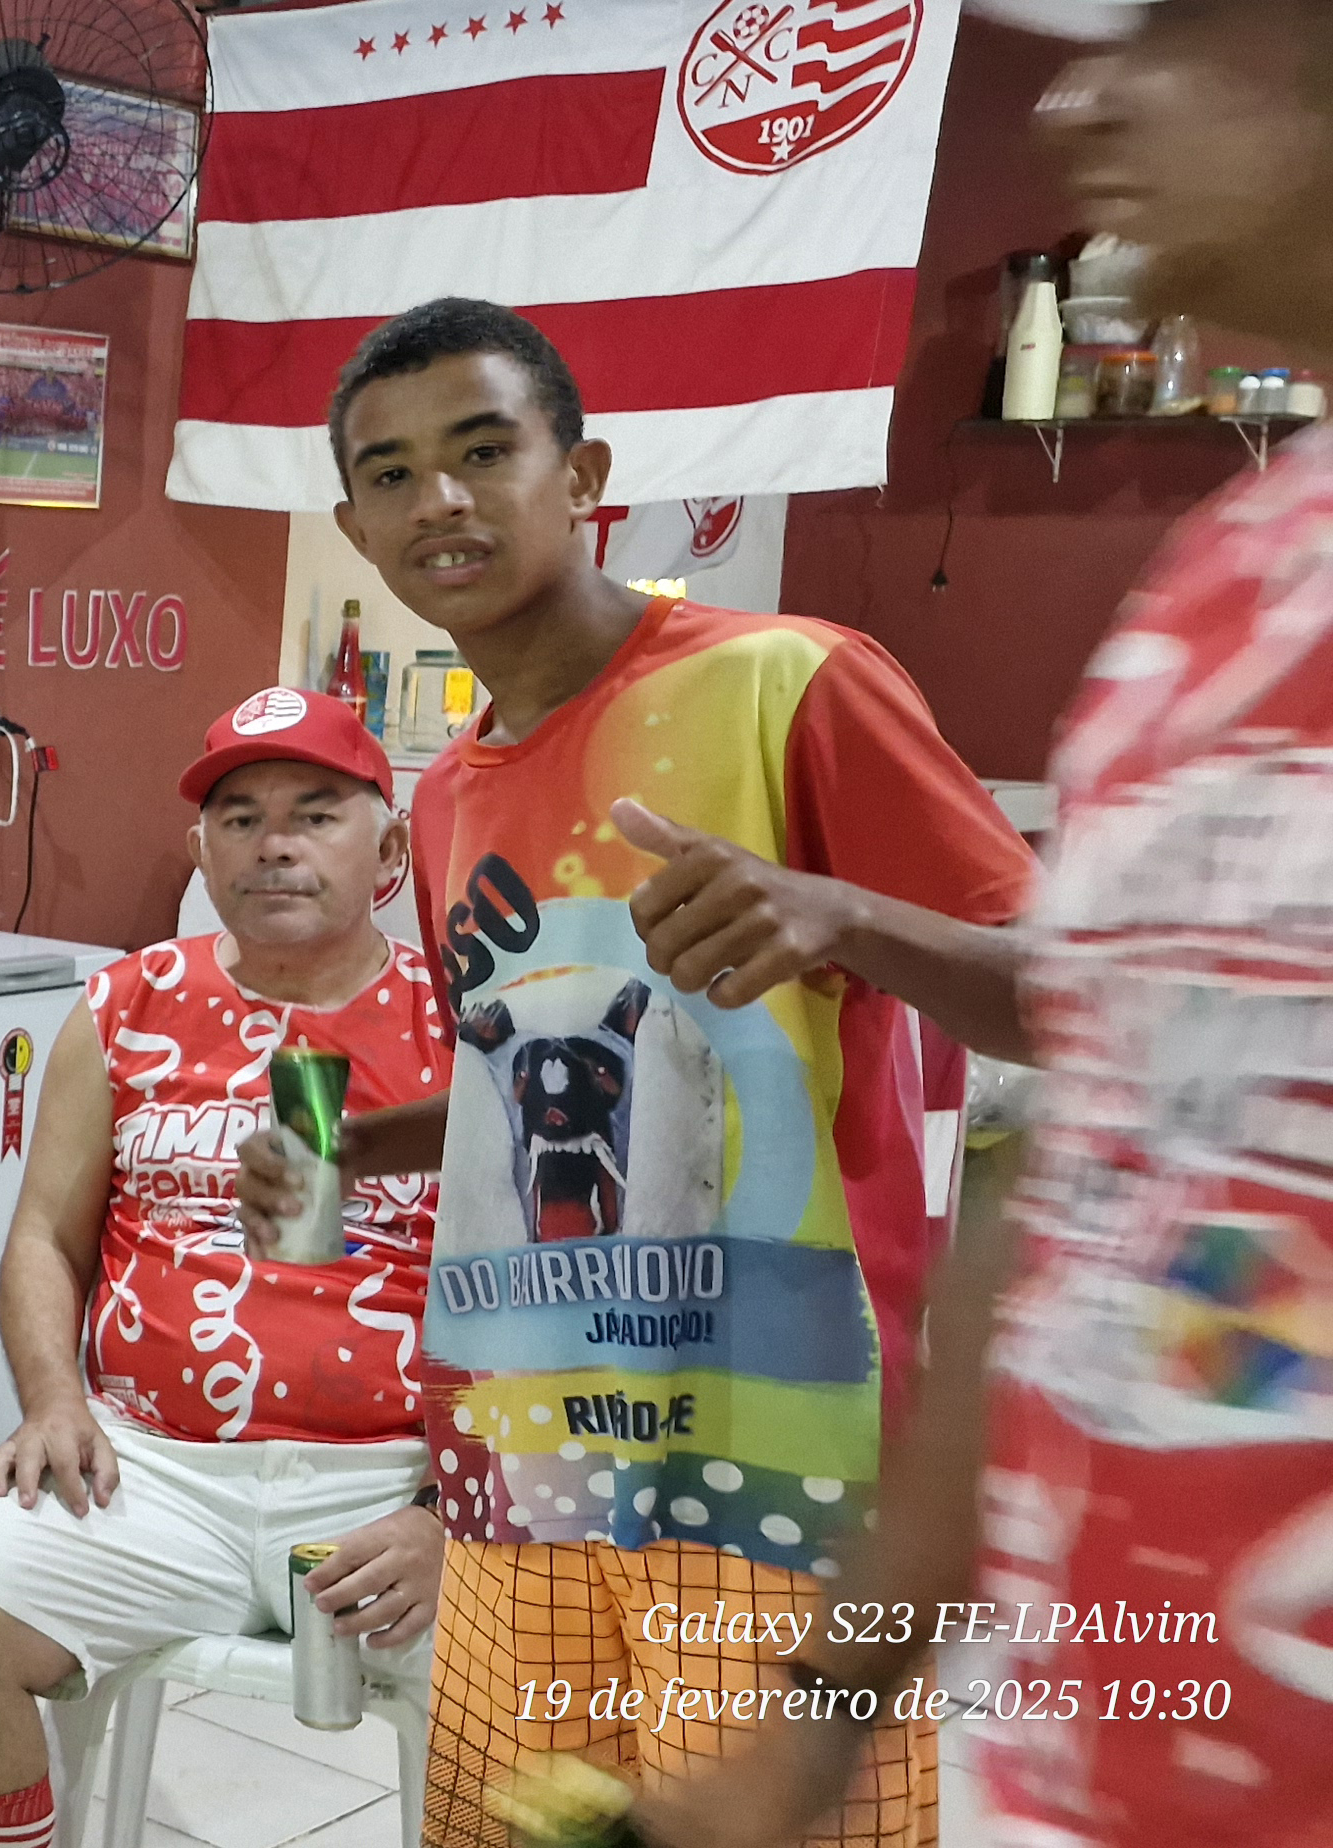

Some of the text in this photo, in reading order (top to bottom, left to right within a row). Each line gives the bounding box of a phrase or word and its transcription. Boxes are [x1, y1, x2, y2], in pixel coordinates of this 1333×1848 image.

[757, 114, 815, 145] 1901
[27, 587, 188, 672] LUXO
[438, 1258, 501, 1315] DO
